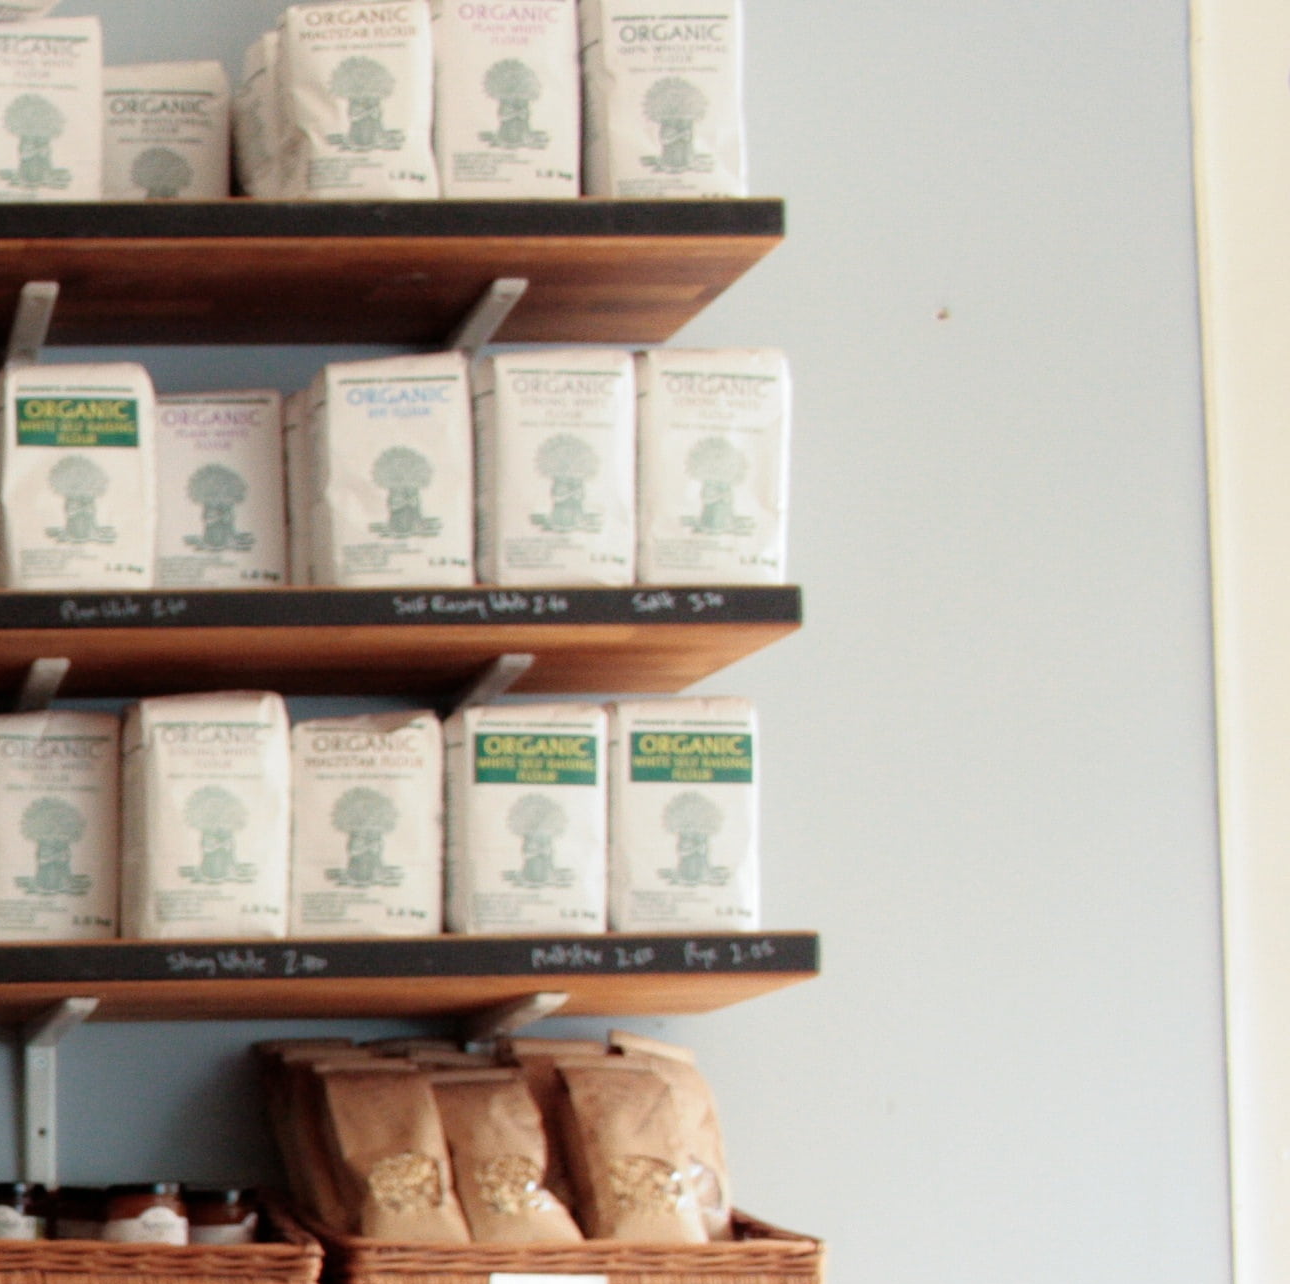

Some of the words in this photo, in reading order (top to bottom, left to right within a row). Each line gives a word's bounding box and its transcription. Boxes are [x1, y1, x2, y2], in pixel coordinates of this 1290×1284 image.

[24, 399, 129, 421] ORGANIC
[482, 734, 590, 757] ORGANIC
[638, 733, 745, 756] ORGANIC
